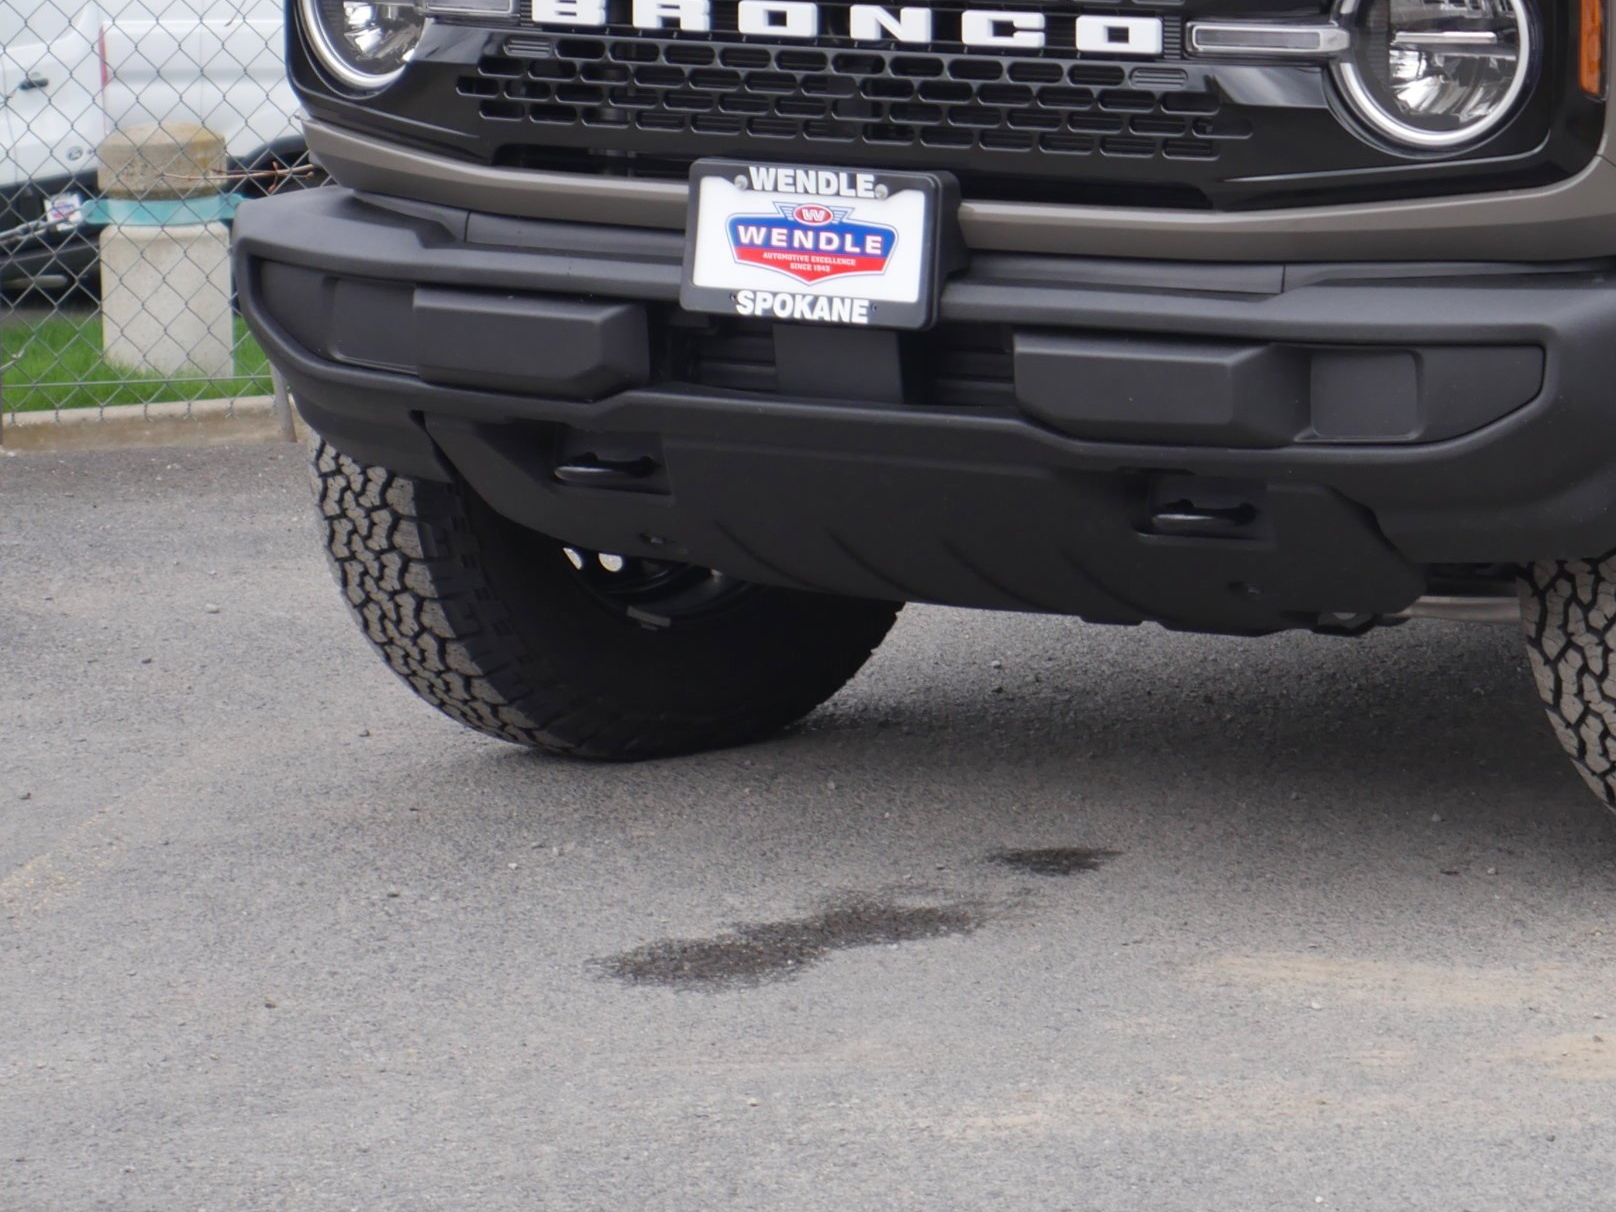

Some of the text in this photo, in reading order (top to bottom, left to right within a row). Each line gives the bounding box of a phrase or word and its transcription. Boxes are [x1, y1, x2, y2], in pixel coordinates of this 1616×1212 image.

[749, 166, 876, 198] WENDLE
[737, 225, 882, 255] WENDLE
[763, 252, 856, 266] AUTOMOTIVE EXCELLENCE
[790, 263, 812, 272] SINCE
[736, 290, 869, 324] SPOKANE
